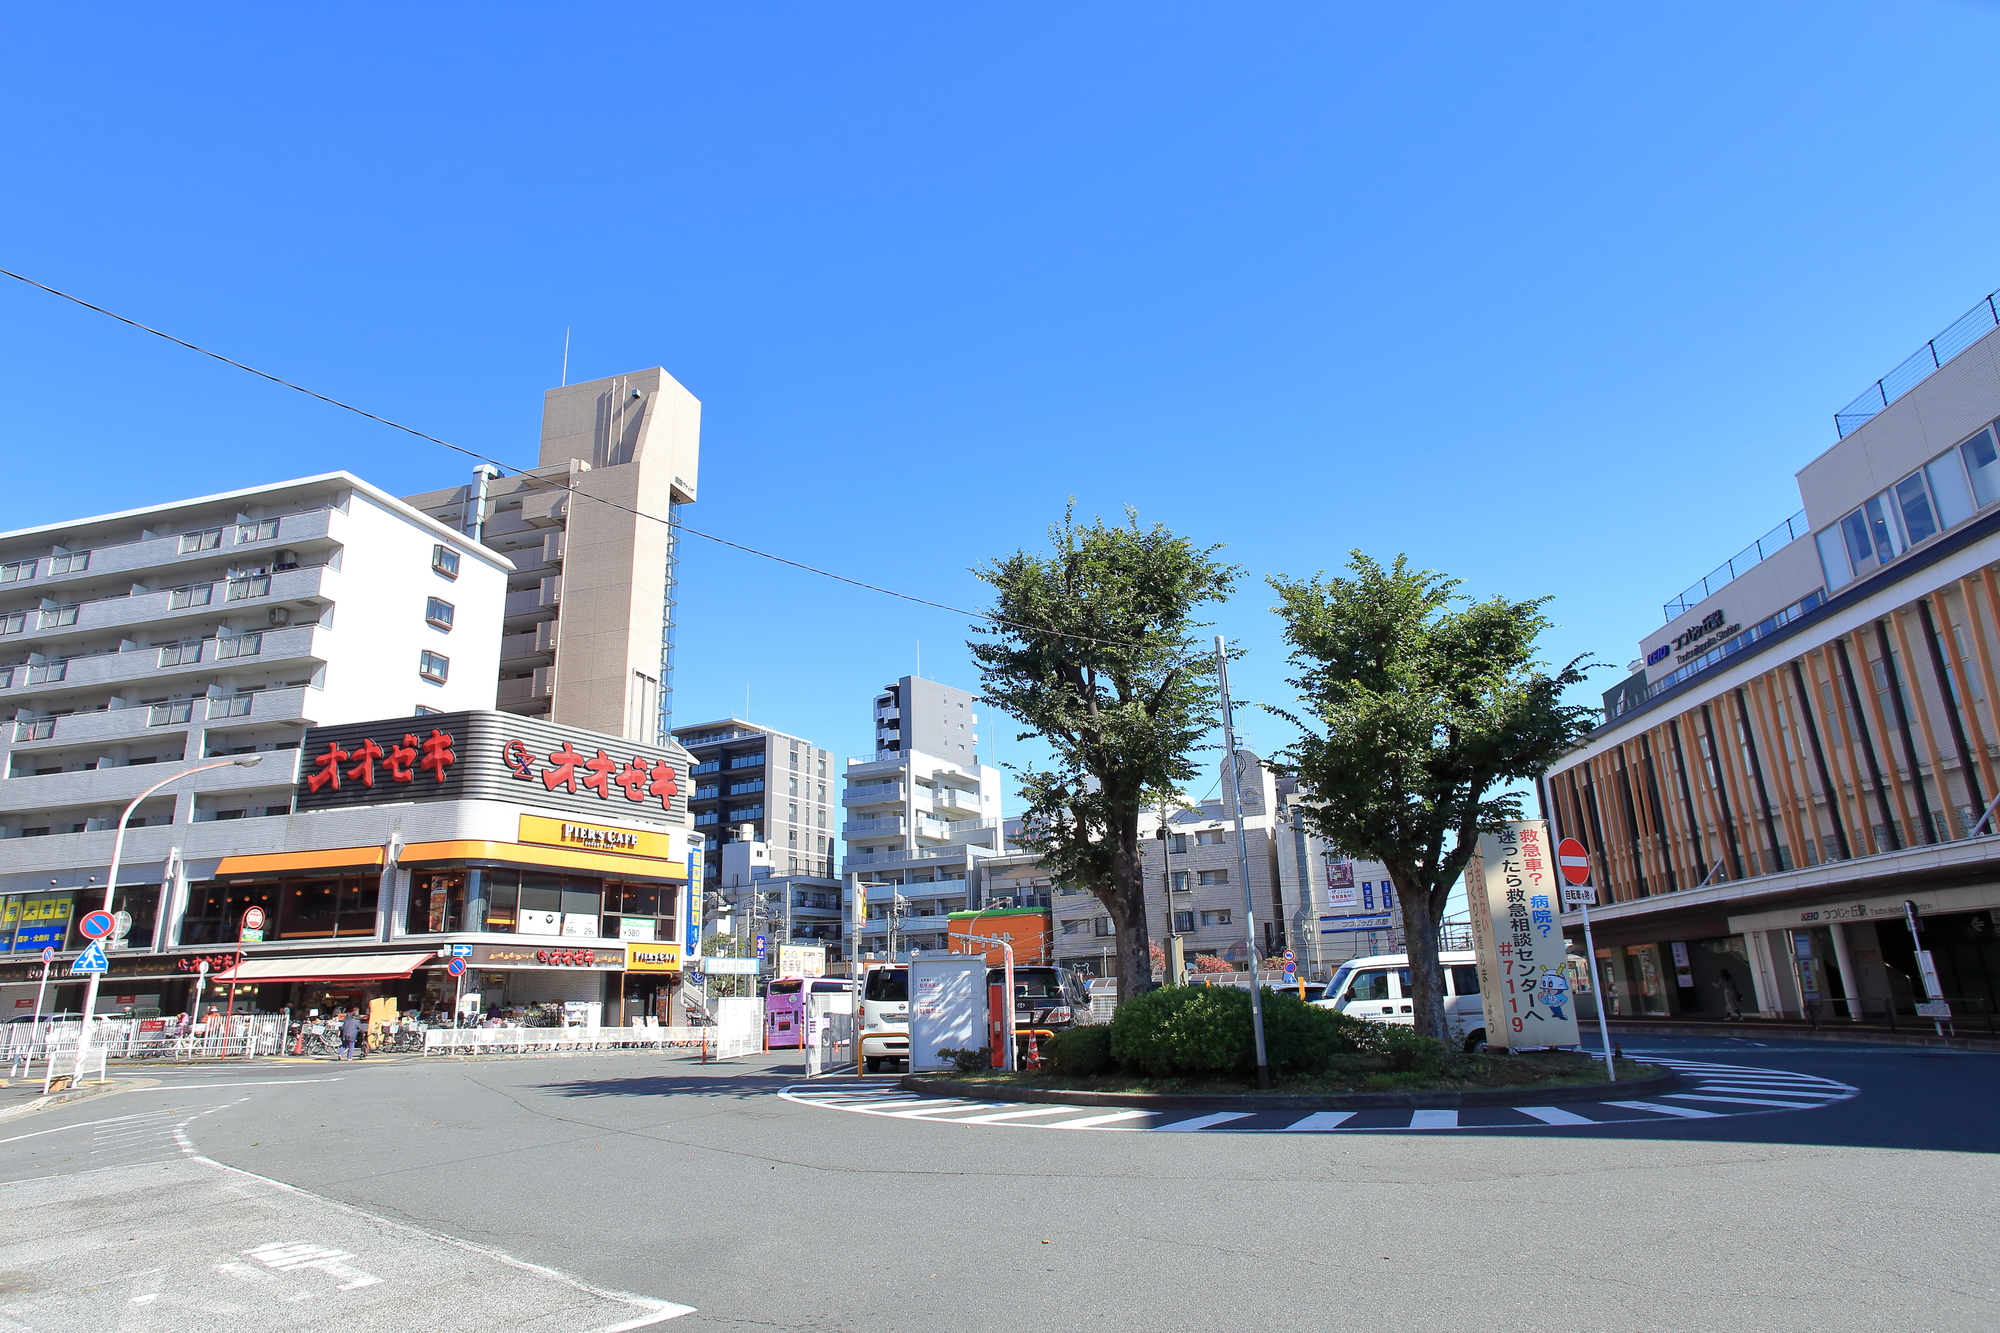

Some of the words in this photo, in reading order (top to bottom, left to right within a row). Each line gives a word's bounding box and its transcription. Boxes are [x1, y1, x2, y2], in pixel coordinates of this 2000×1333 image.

[1716, 623, 1740, 641] Station
[1647, 644, 1669, 667] KEIO
[307, 728, 456, 793] オオゼキ
[542, 742, 678, 811] オオゼキ
[563, 823, 605, 841] PIER'S
[607, 830, 638, 845] CAFE
[1565, 889, 1594, 900] 自転車を除く
[1801, 911, 1819, 922] KEIO
[1823, 904, 1868, 920] つつじヶ丘駅
[1498, 829, 1545, 1022] 迷ったら救急相談センターへ
[548, 949, 595, 966] オオゼキ
[1498, 941, 1524, 1033] #7119
